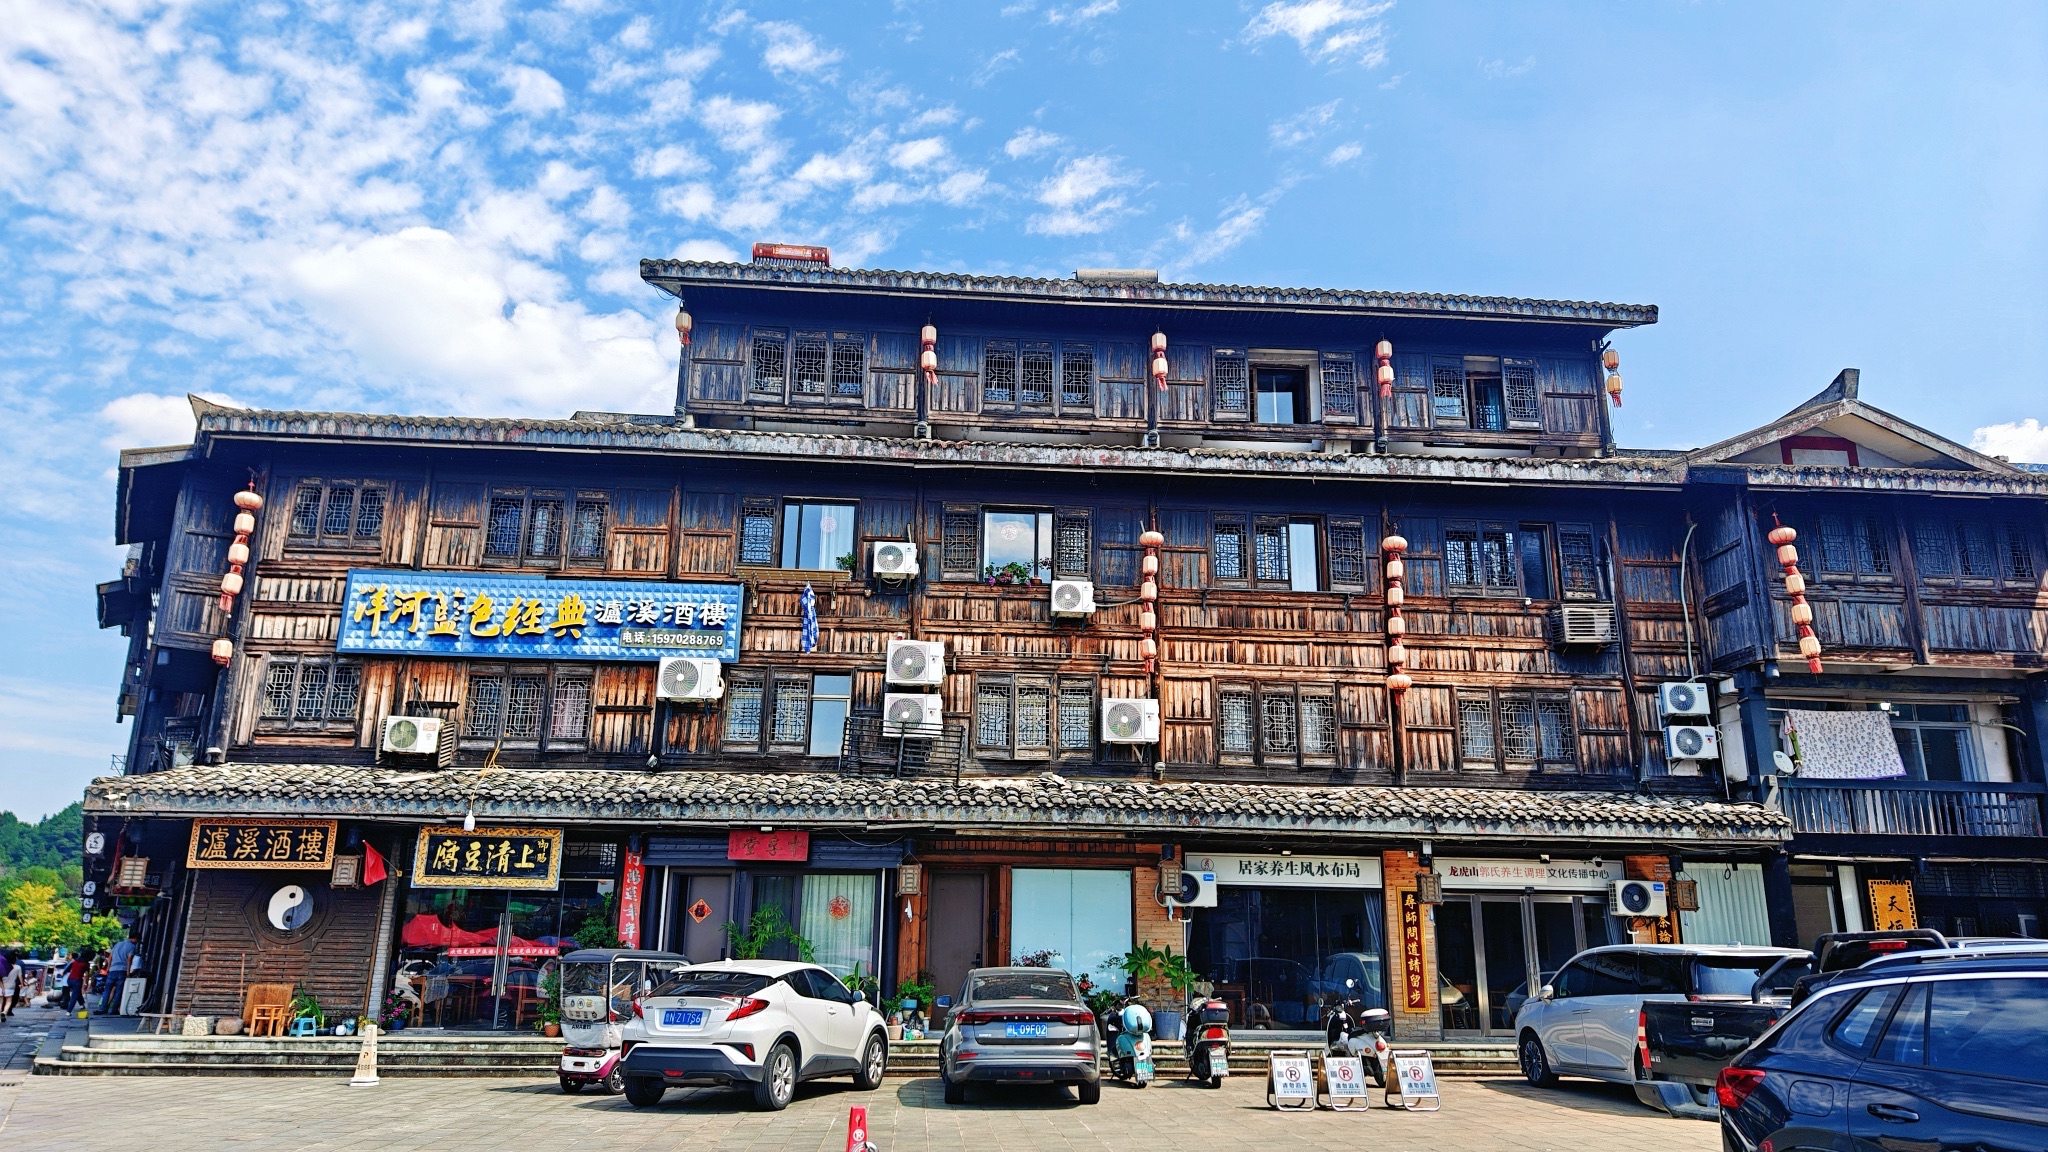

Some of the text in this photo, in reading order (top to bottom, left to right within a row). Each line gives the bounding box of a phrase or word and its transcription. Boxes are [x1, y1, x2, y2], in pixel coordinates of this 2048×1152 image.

[622, 631, 723, 646] 电话:15970288769
[1238, 860, 1360, 878] 居家养生风水布局
[1404, 894, 1421, 1005] 尋師問道請留步
